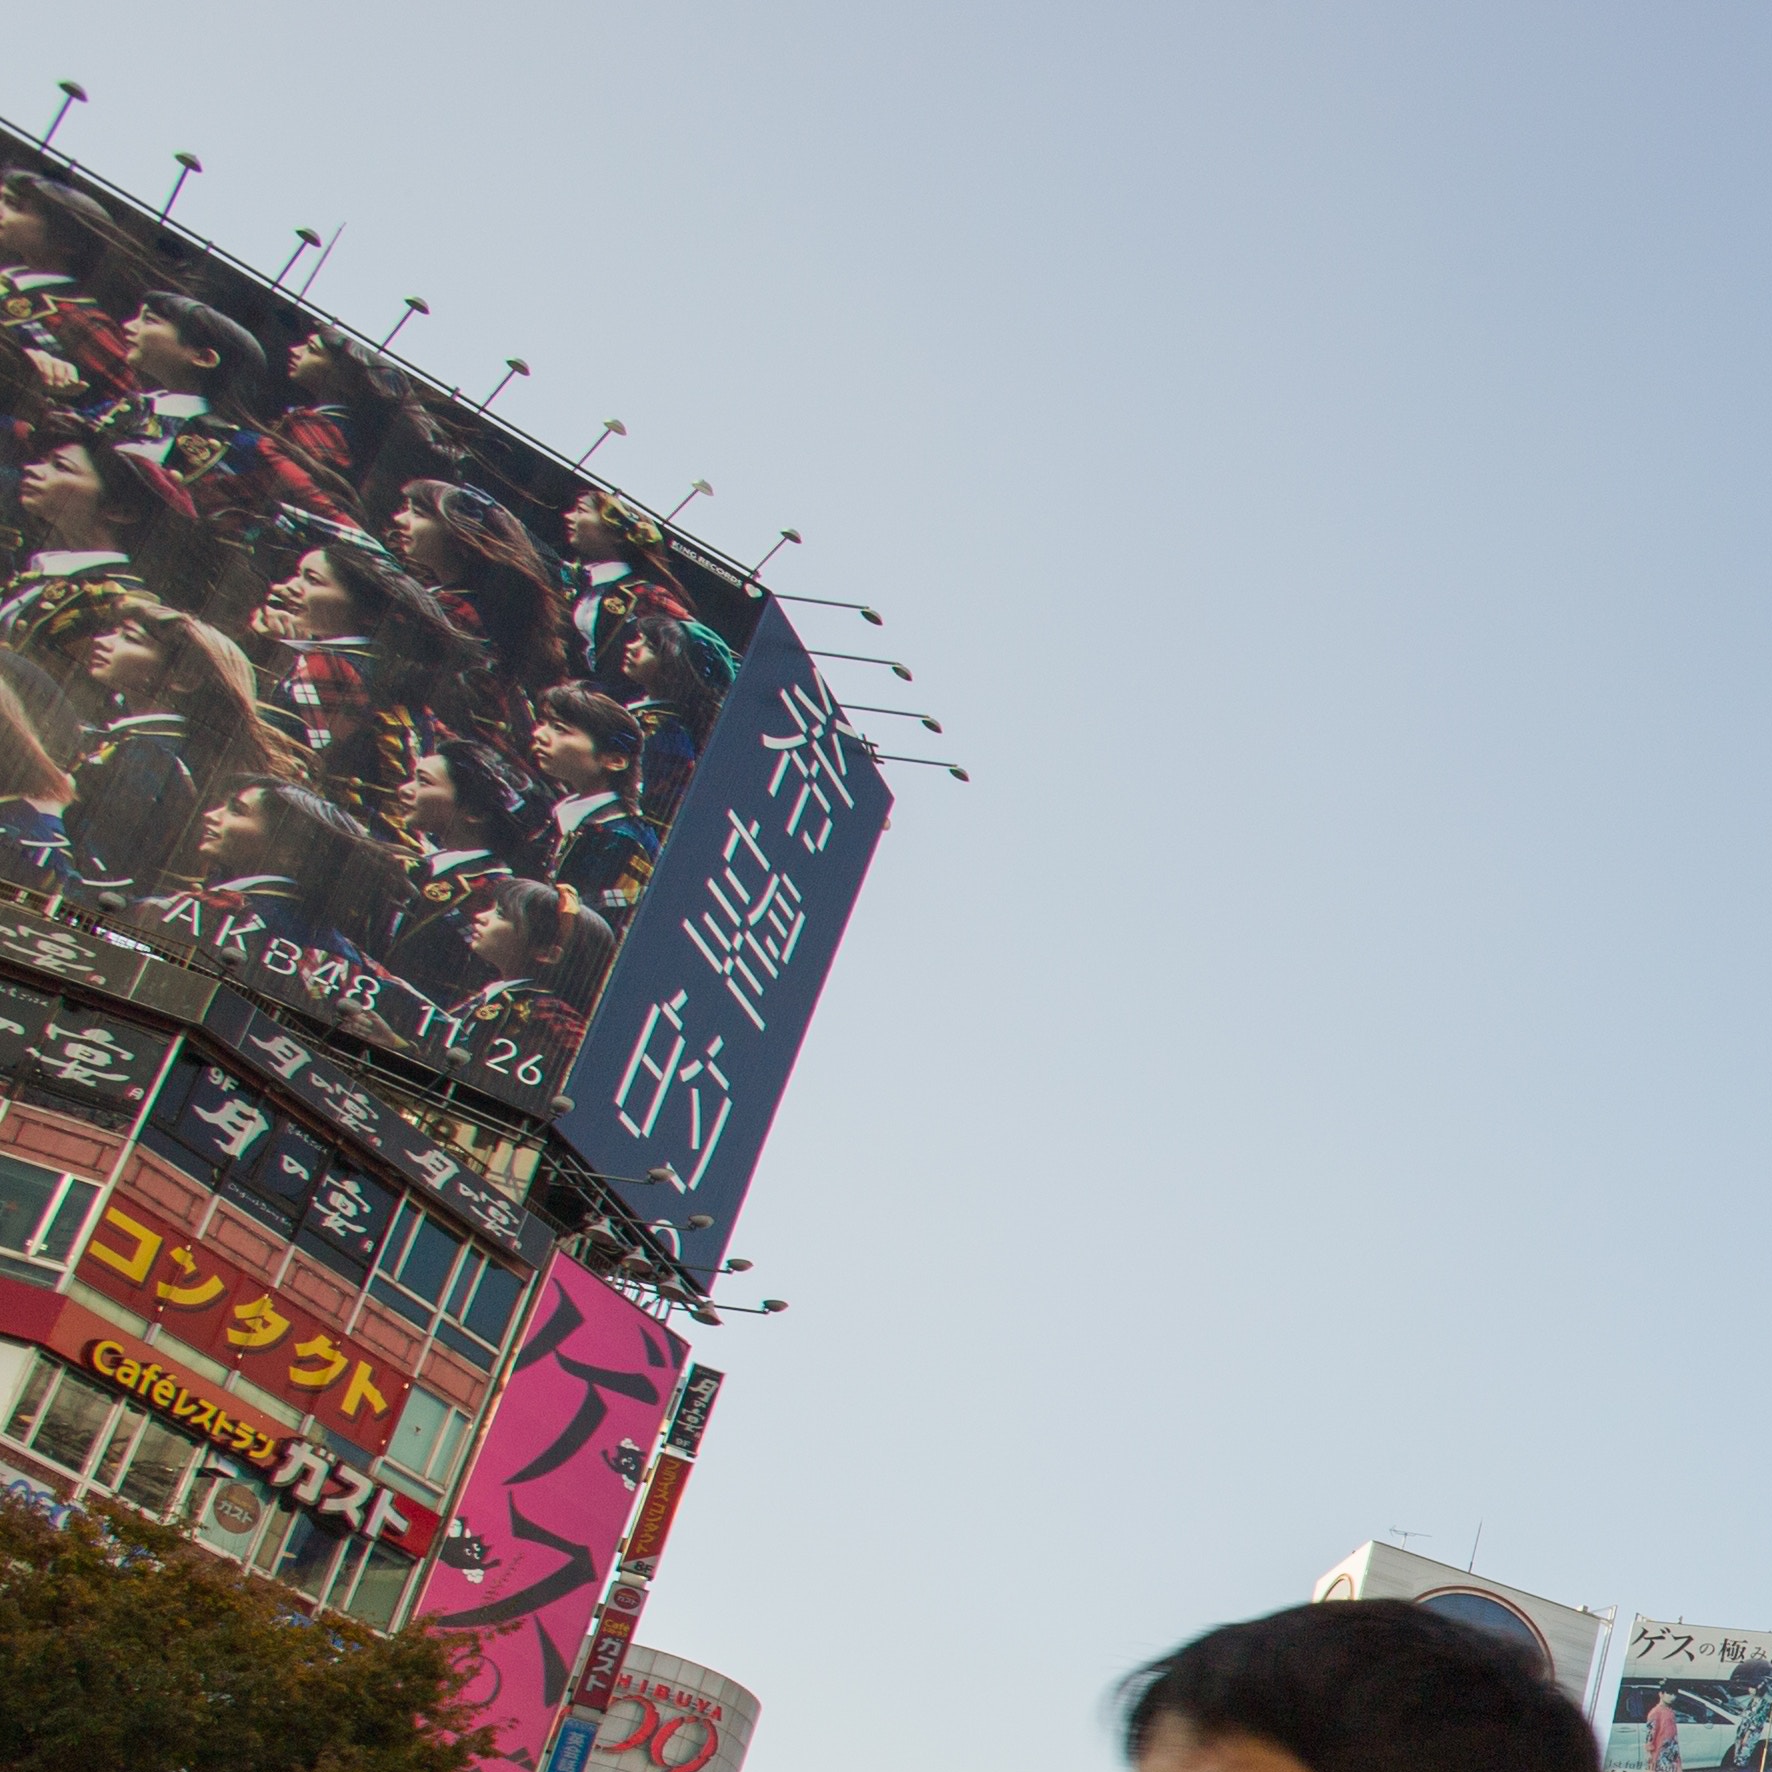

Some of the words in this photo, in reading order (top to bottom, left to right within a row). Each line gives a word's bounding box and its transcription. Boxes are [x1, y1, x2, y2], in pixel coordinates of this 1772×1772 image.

[670, 540, 698, 561] KING
[697, 555, 743, 590] RECORDS
[0, 923, 107, 973] 宴
[163, 896, 381, 1012] AKB48
[207, 1066, 240, 1092] 9F
[249, 1033, 380, 1134] 月の宴
[191, 1098, 373, 1237] 月の宴
[404, 1145, 521, 1240] 月の宴
[87, 1206, 389, 1416] コンタクト
[271, 1440, 409, 1537] ガスト
[634, 1560, 655, 1575] 8F
[584, 1635, 629, 1693] ガスト
[617, 1672, 724, 1723] HIBUYA
